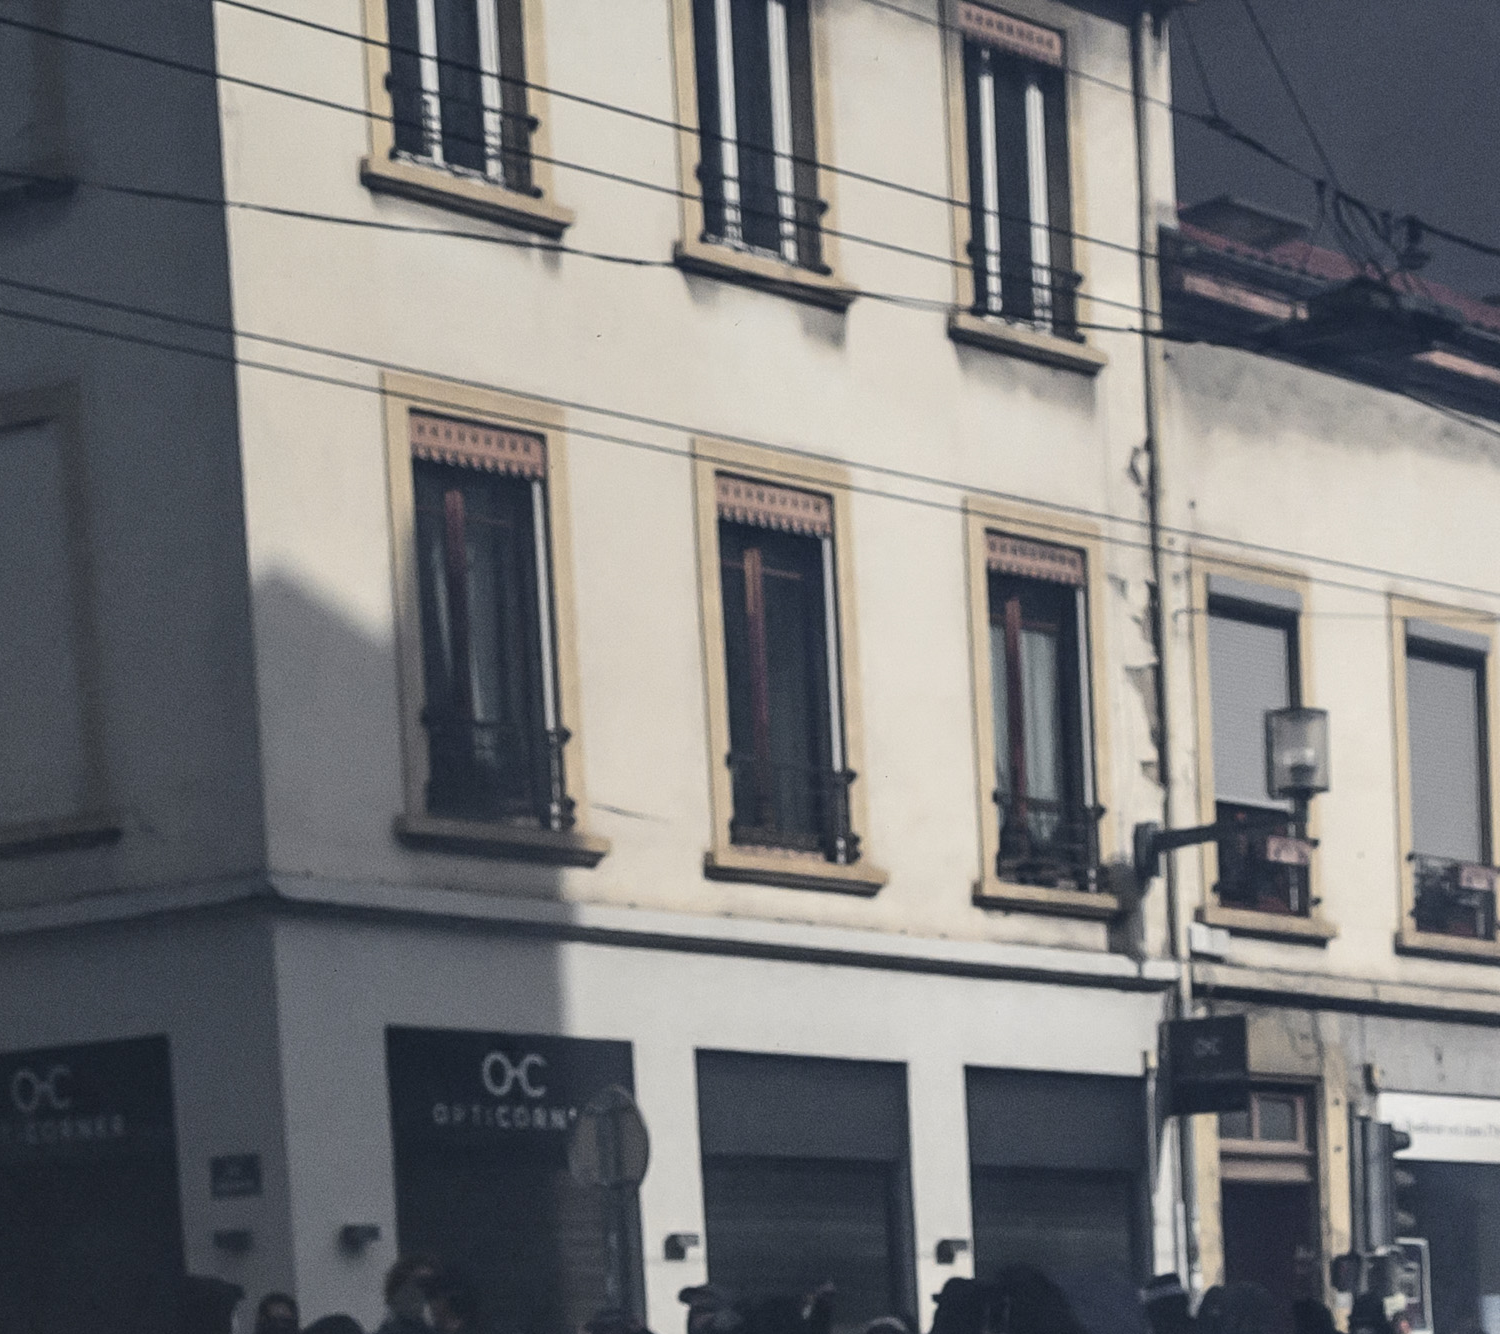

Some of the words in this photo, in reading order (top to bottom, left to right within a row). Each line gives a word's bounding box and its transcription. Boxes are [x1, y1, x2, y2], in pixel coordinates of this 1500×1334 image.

[11, 1063, 73, 1112] OC
[481, 1050, 549, 1098] OC
[431, 1102, 578, 1131] OPTICORN
